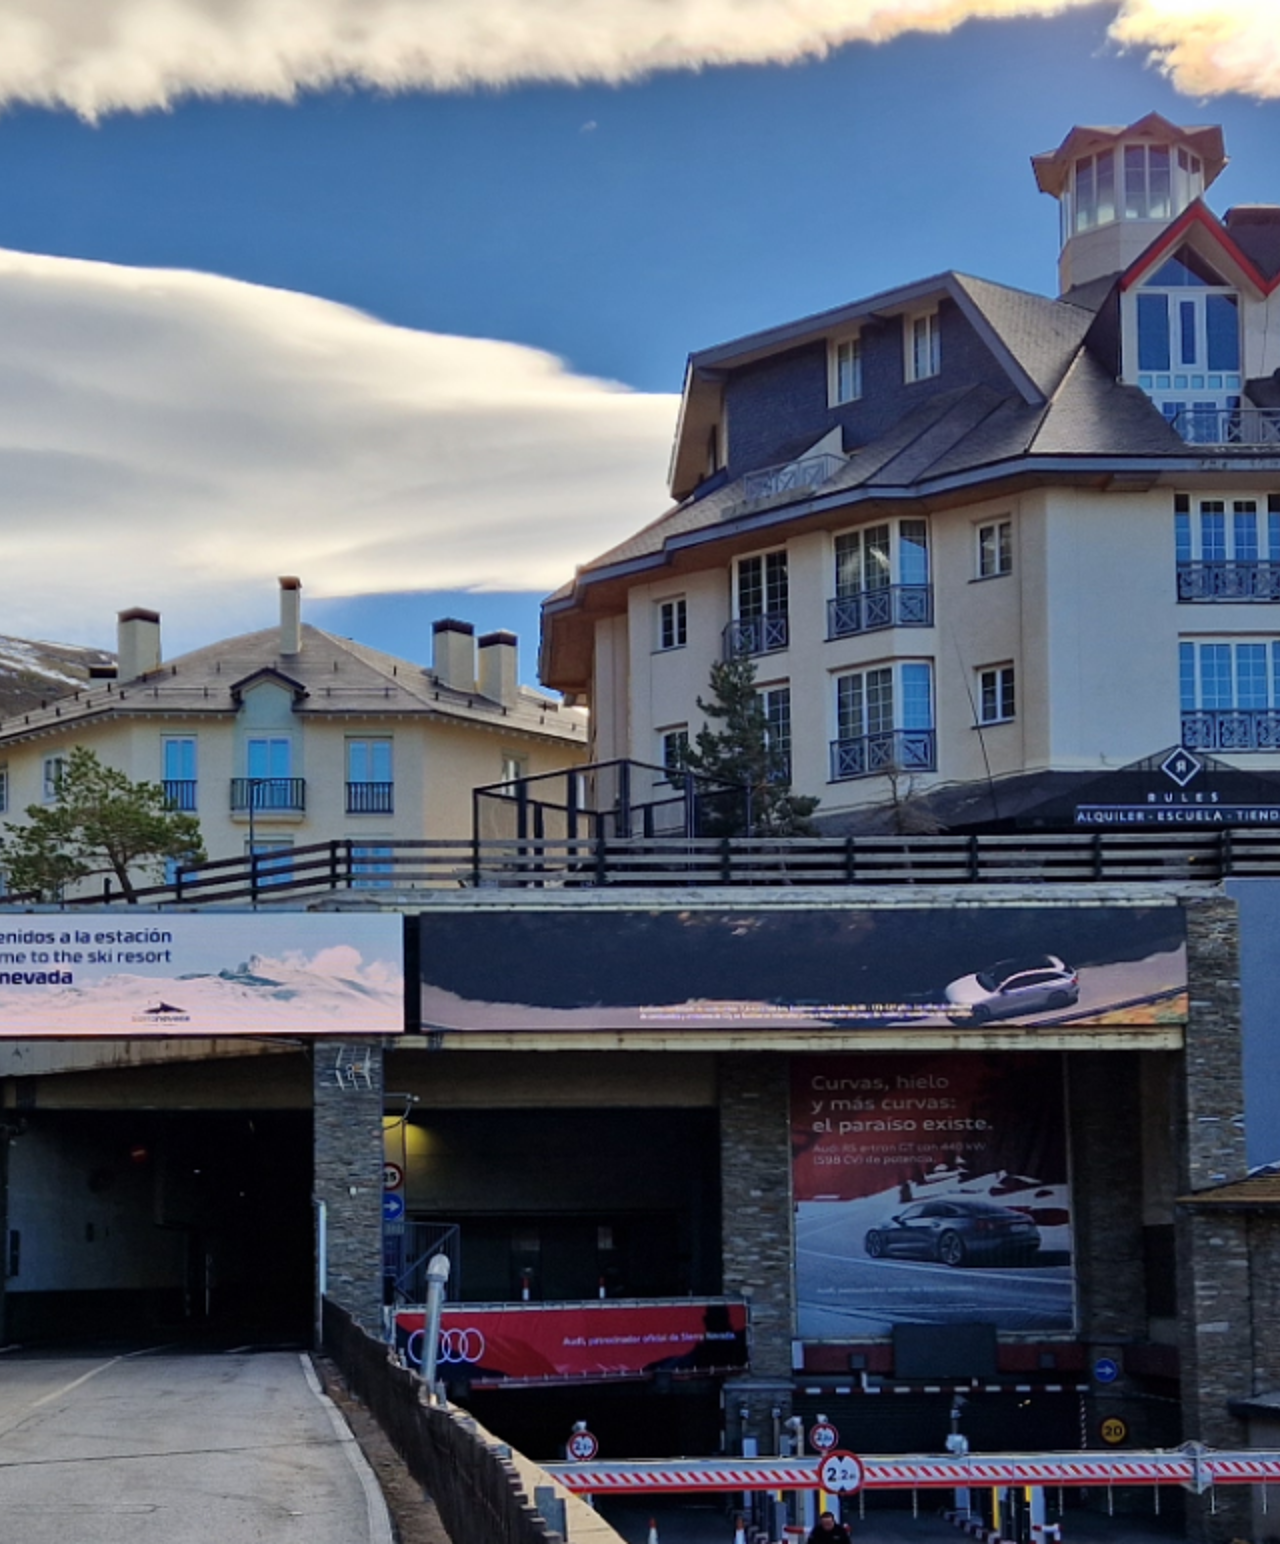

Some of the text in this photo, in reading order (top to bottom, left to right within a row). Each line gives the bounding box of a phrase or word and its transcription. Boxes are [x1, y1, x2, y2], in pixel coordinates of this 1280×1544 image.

[1147, 792, 1219, 803] RULES
[1077, 810, 1145, 822] ALQUILER
[1157, 810, 1223, 822] ESCUELA
[59, 932, 70, 944] a
[75, 929, 91, 944] la
[94, 928, 172, 944] estación
[31, 950, 49, 964] to
[53, 949, 83, 964] the
[87, 948, 113, 963] ski
[117, 950, 172, 963] resort
[811, 1074, 949, 1093] Curvas, hielo
[810, 1095, 956, 1115] y más curvas:
[812, 1116, 993, 1135] el paraíso existe.
[1104, 1425, 1123, 1437] 20
